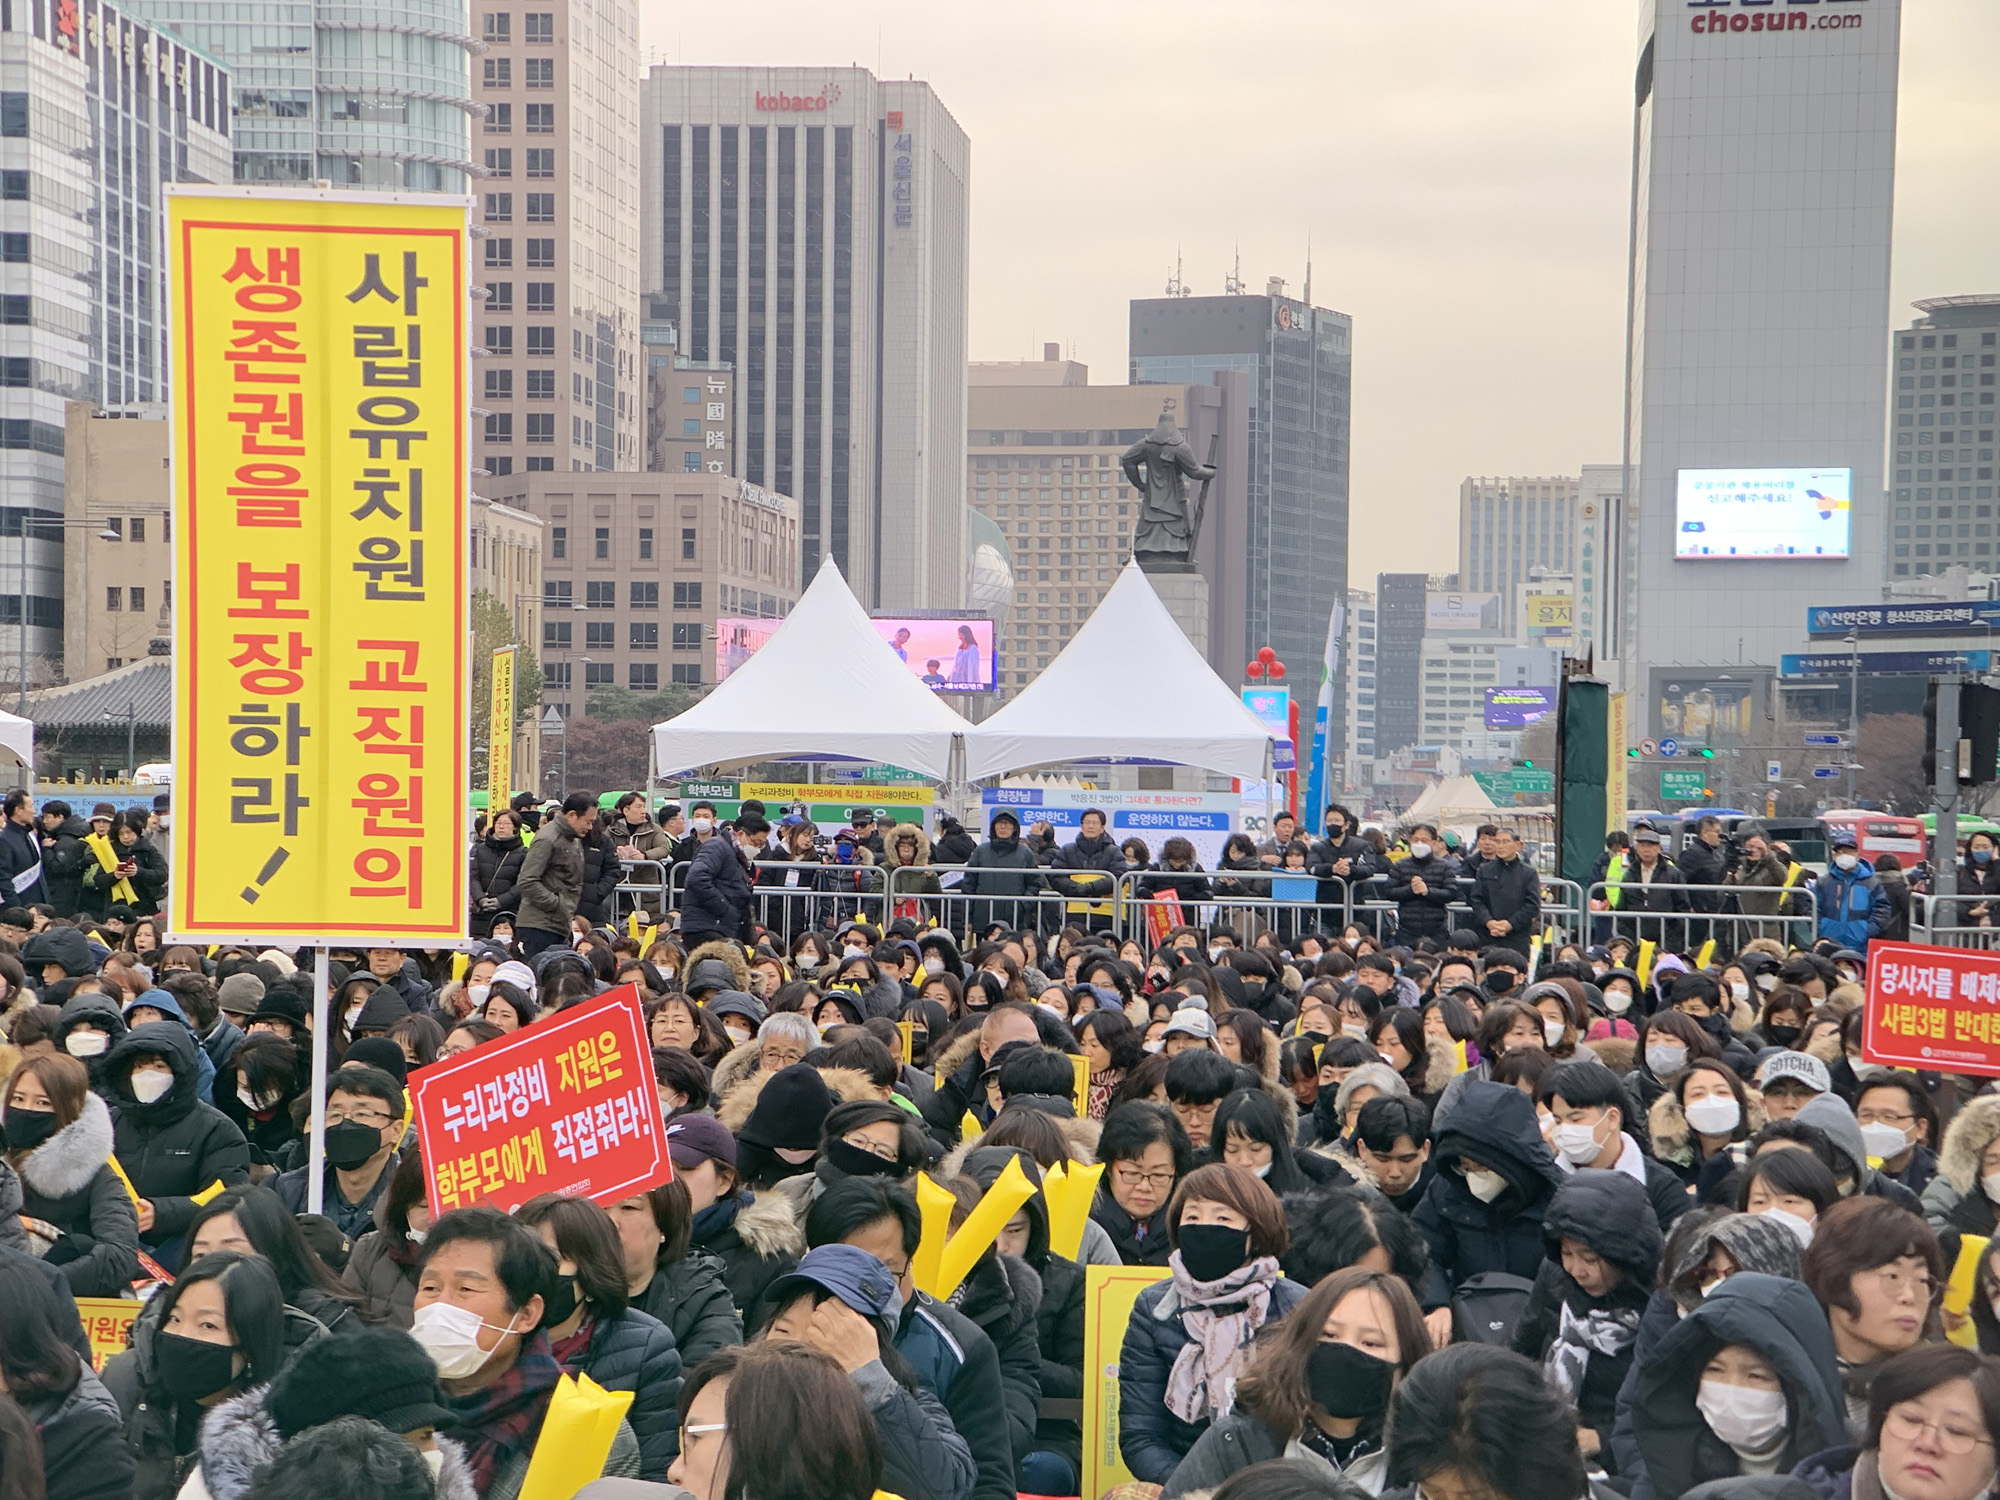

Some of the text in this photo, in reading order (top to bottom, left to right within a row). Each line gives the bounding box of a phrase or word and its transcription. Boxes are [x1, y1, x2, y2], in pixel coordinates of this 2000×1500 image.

[1691, 10, 1862, 33] chosun.com
[755, 90, 827, 112] kobaco
[892, 133, 913, 226] 서울신문
[222, 246, 314, 906] 생존권을 보장하라!
[345, 250, 430, 909] 사립유치원 교직원의
[1831, 610, 1881, 626] 신한은행
[1664, 773, 1701, 783] 종로1가
[687, 784, 733, 798] 학부모님
[749, 787, 922, 801] 누리과정비 학부모에게 직접 지원해야한다.
[996, 790, 1031, 802] 원장님
[1070, 793, 1203, 806] 박용진 3법이 그대로 통과된다면?
[1023, 811, 1072, 824] 운영한다.
[1127, 813, 1214, 827] 운영하지 않는다.
[1880, 963, 1954, 999] 당사자를
[1880, 1003, 1947, 1039] 사립3법
[1770, 1057, 1815, 1075] GOTCHA
[442, 1030, 623, 1143] 누리과정비 지원은
[436, 1086, 650, 1210] 학부모에게 직접줘라!
